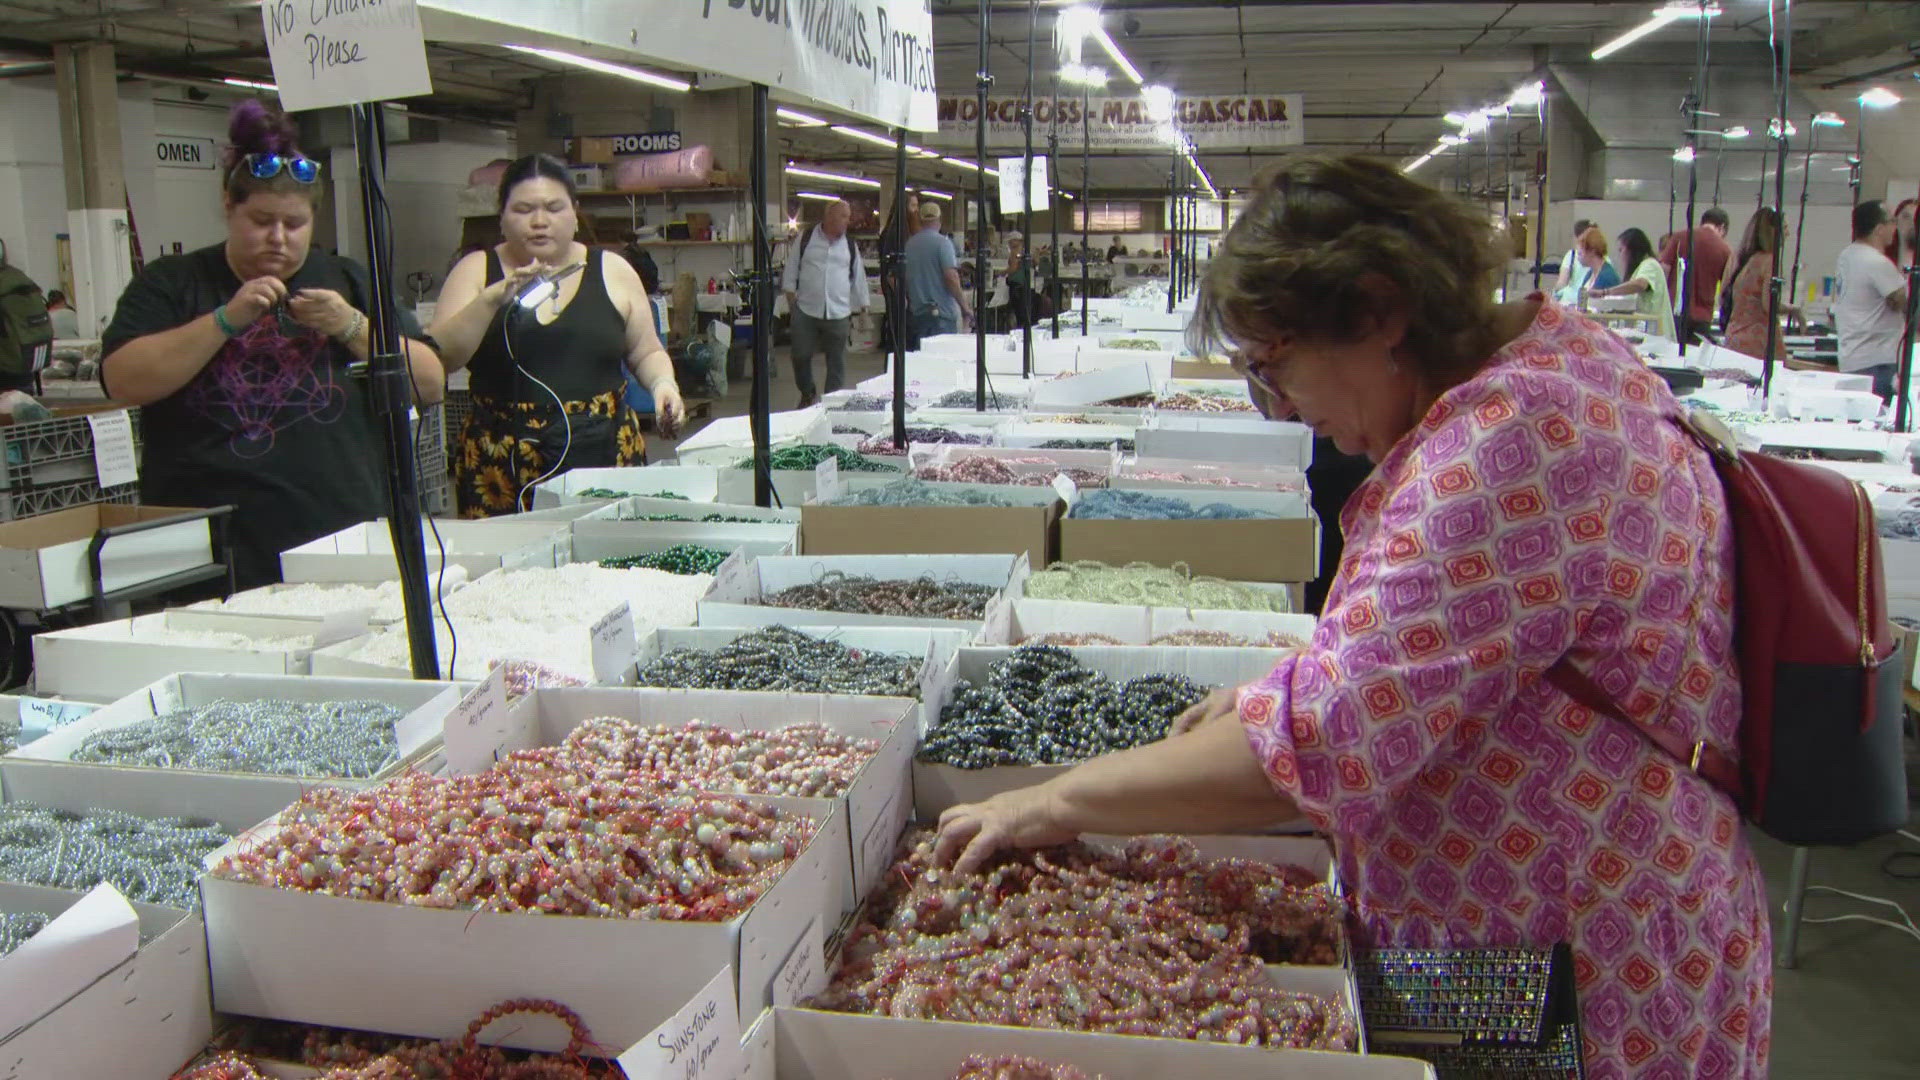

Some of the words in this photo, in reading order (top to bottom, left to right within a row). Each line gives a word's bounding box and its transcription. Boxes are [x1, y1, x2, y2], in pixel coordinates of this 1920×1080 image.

[304, 33, 367, 80] Please
[938, 98, 1082, 124] NORCOSS
[1102, 98, 1288, 124] MAGASCAR
